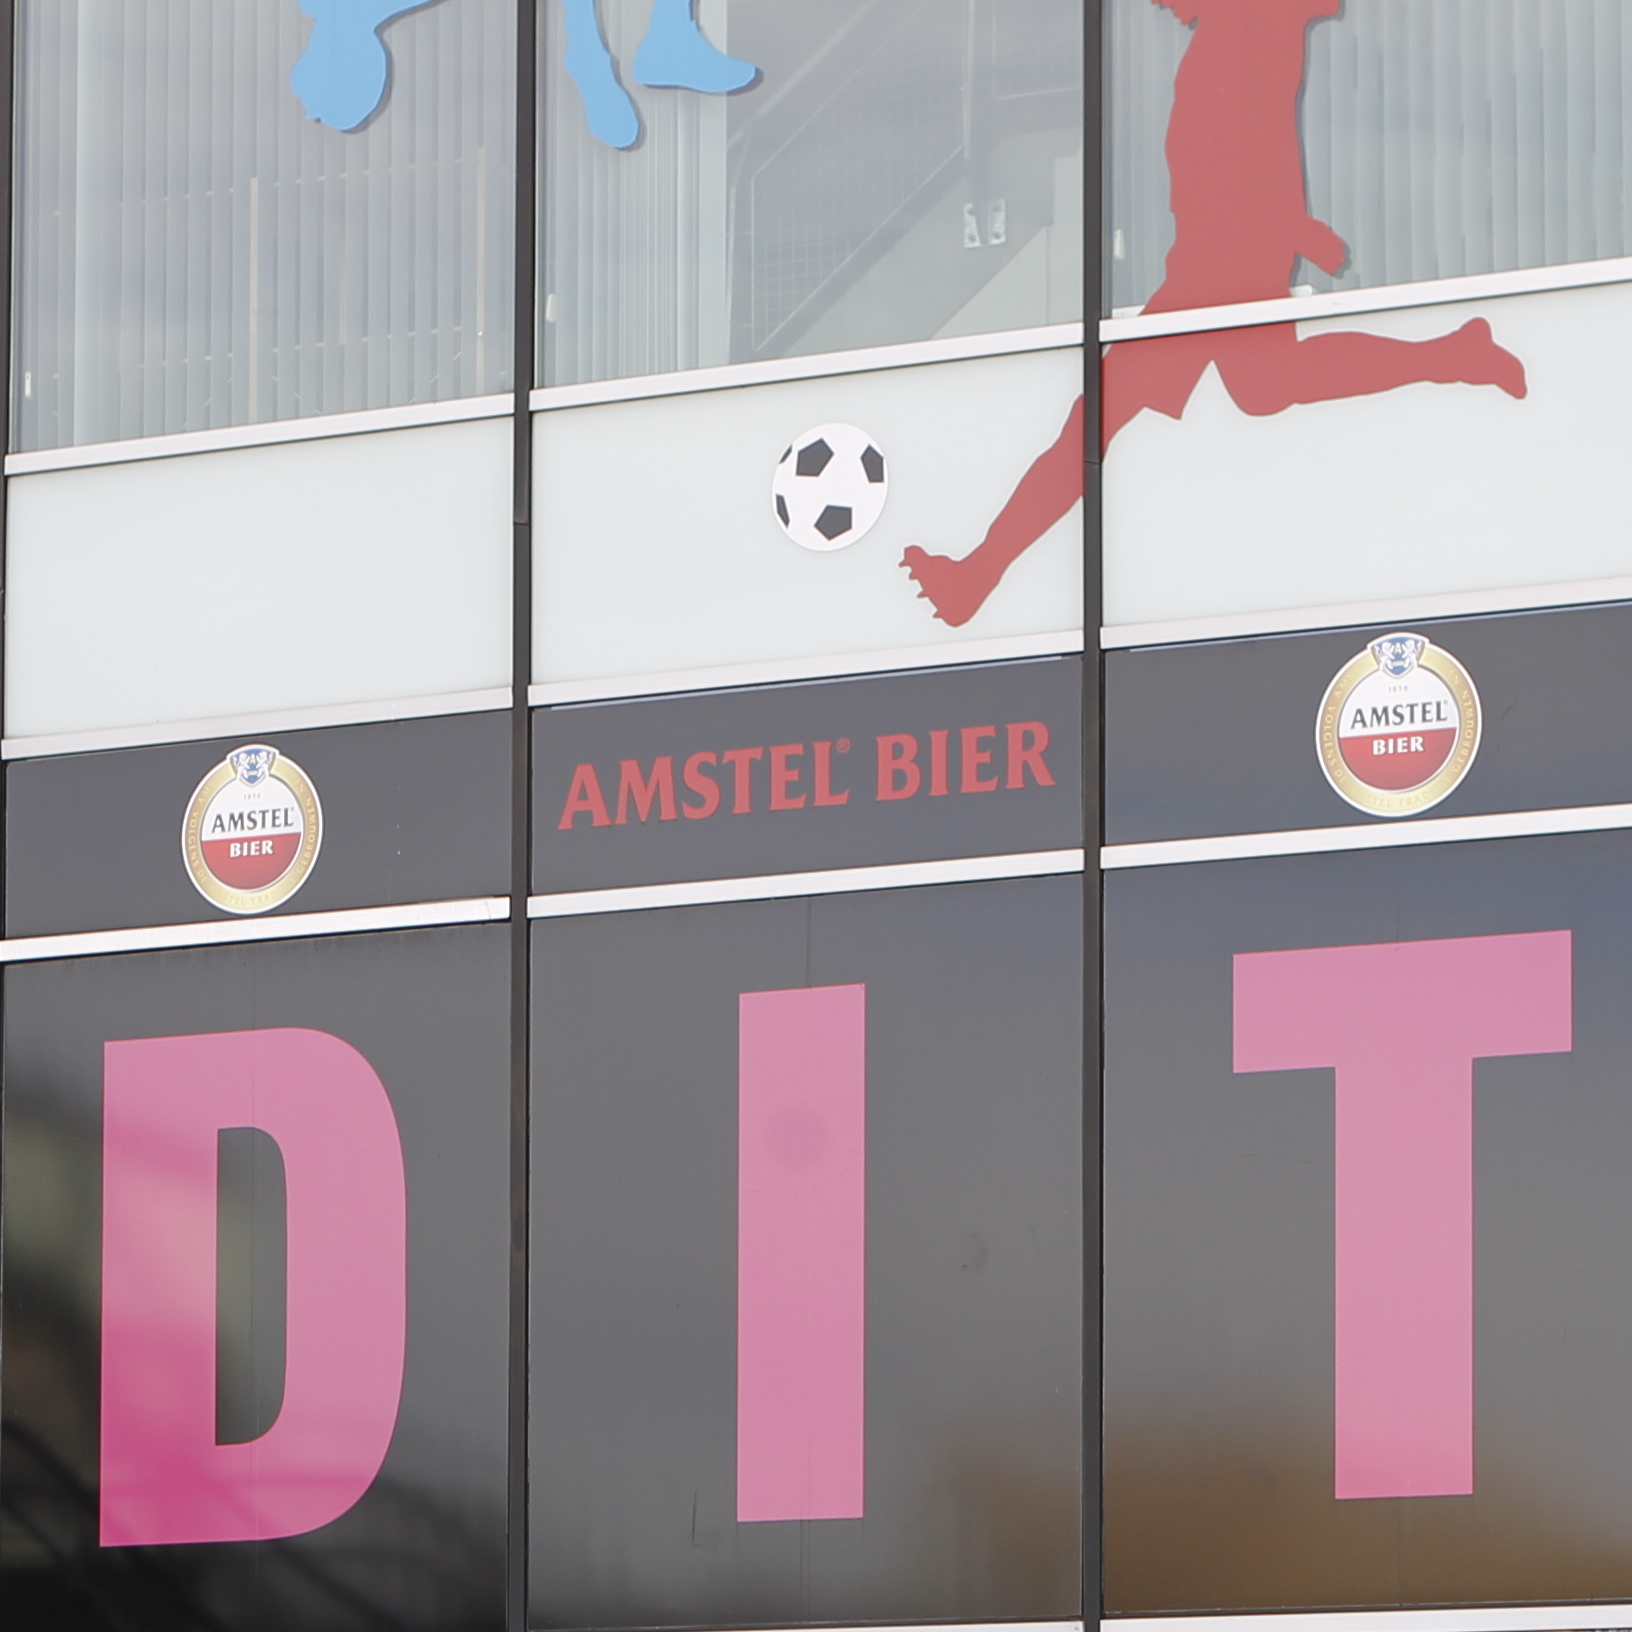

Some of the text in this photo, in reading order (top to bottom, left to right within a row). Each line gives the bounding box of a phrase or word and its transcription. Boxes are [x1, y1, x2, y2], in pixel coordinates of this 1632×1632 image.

[1372, 736, 1424, 755] BIER
[875, 720, 1056, 801] BIER
[230, 840, 274, 858] BIER
